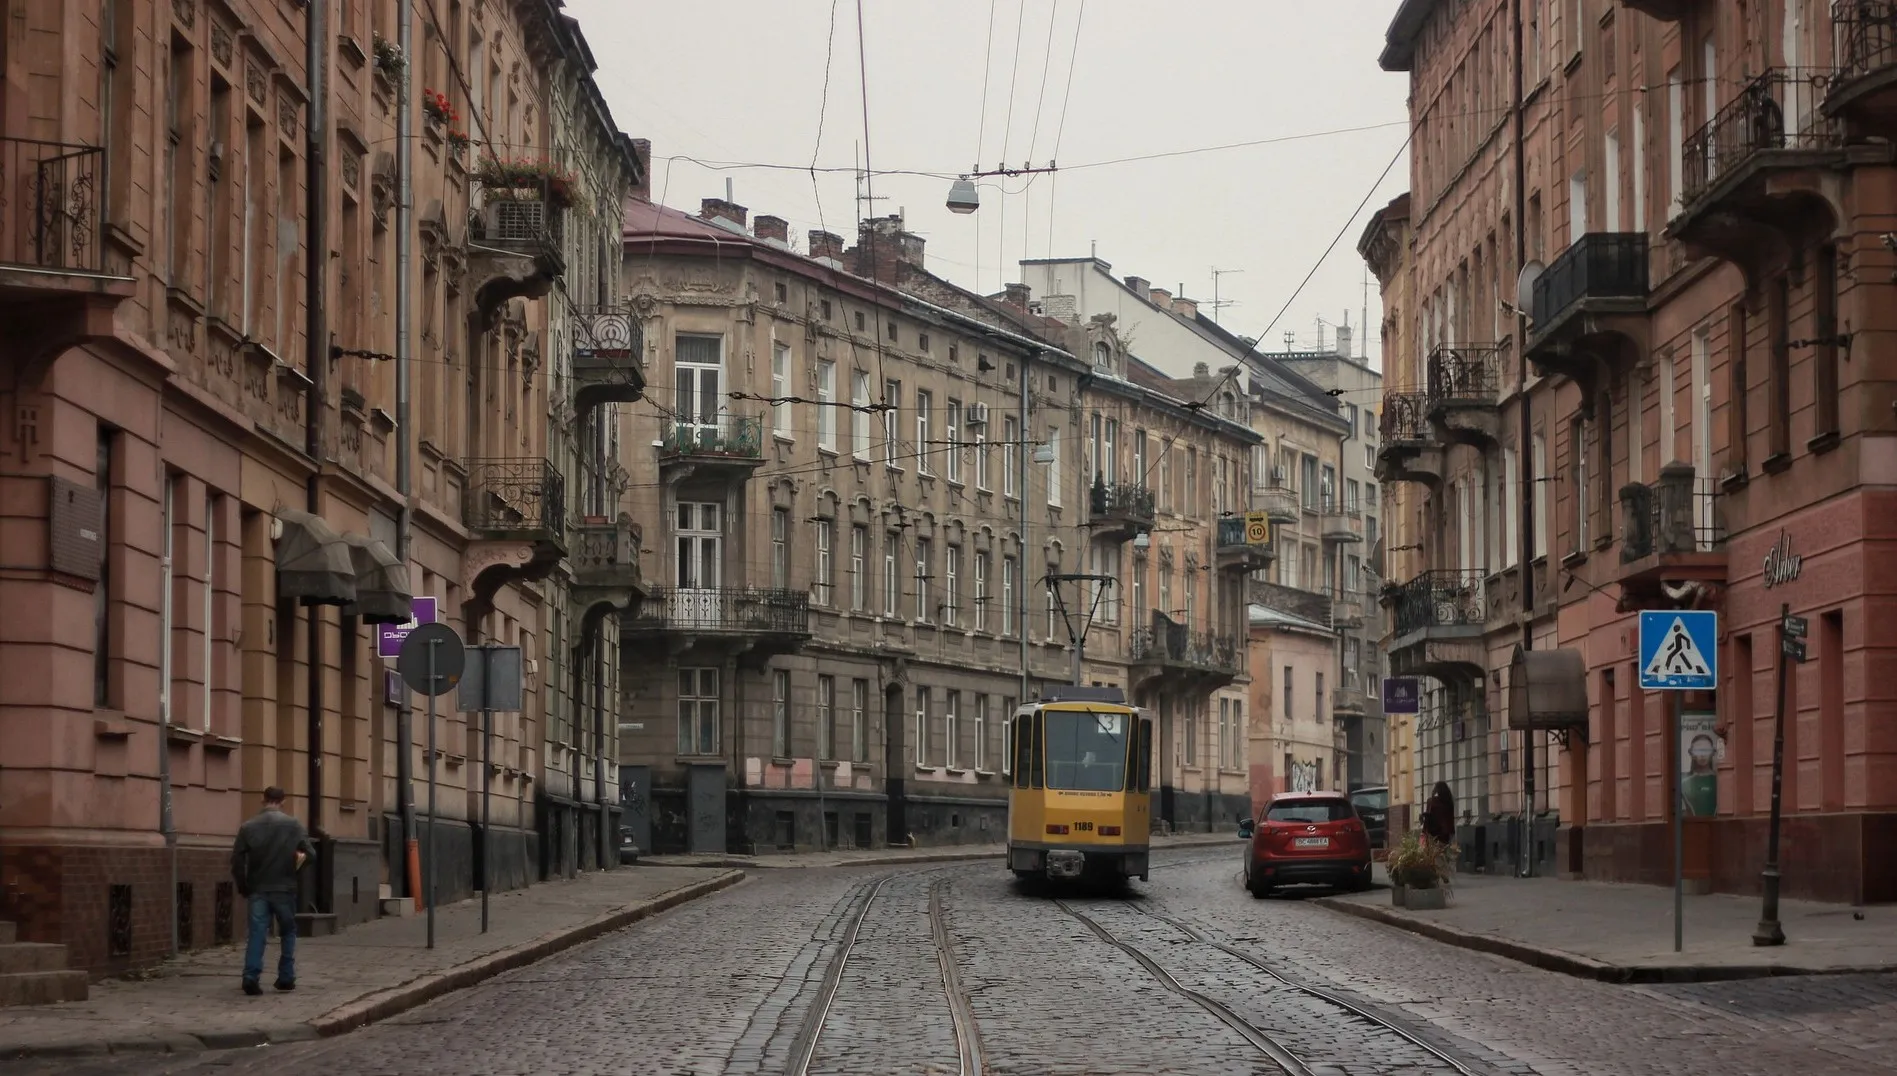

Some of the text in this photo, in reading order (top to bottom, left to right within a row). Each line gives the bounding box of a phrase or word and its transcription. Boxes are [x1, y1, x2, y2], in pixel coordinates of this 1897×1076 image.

[1252, 527, 1263, 536] 10
[1104, 715, 1115, 731] 3
[1073, 821, 1094, 831] 1189
